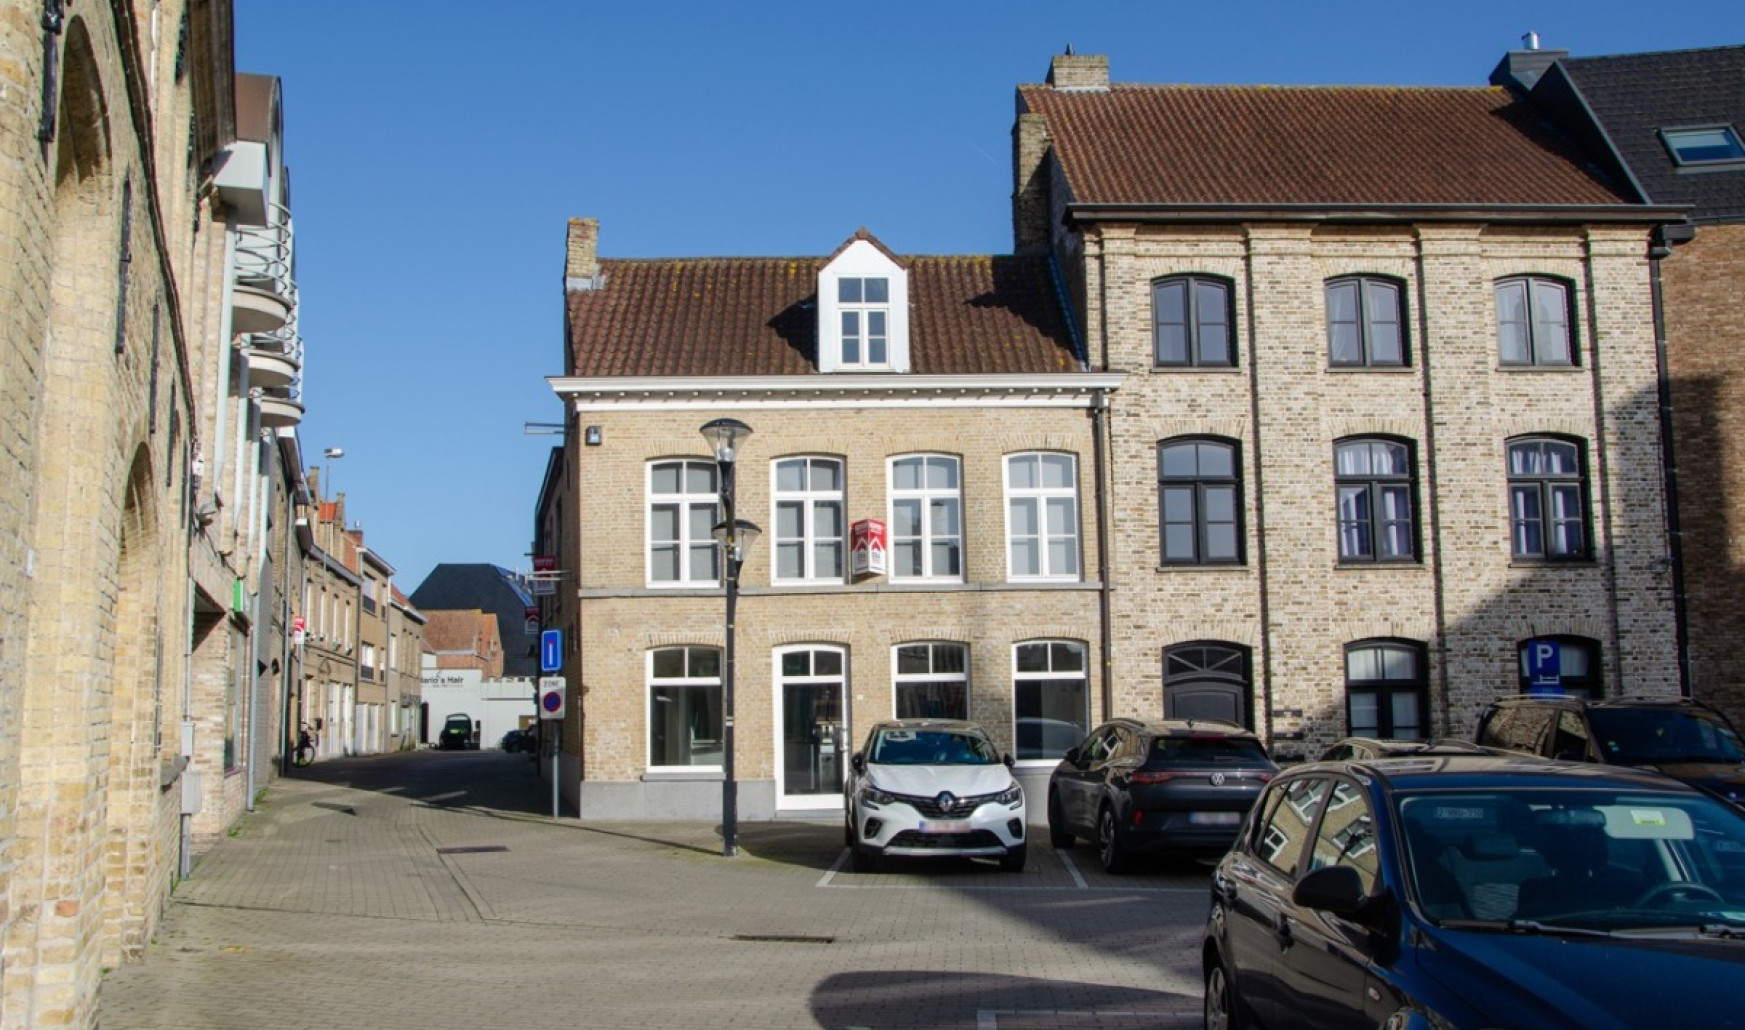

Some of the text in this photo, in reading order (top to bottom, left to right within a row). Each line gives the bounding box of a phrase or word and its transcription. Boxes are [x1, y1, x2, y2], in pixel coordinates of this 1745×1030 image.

[1536, 644, 1554, 669] P
[448, 676, 465, 684] Hair
[544, 680, 560, 688] ZONE
